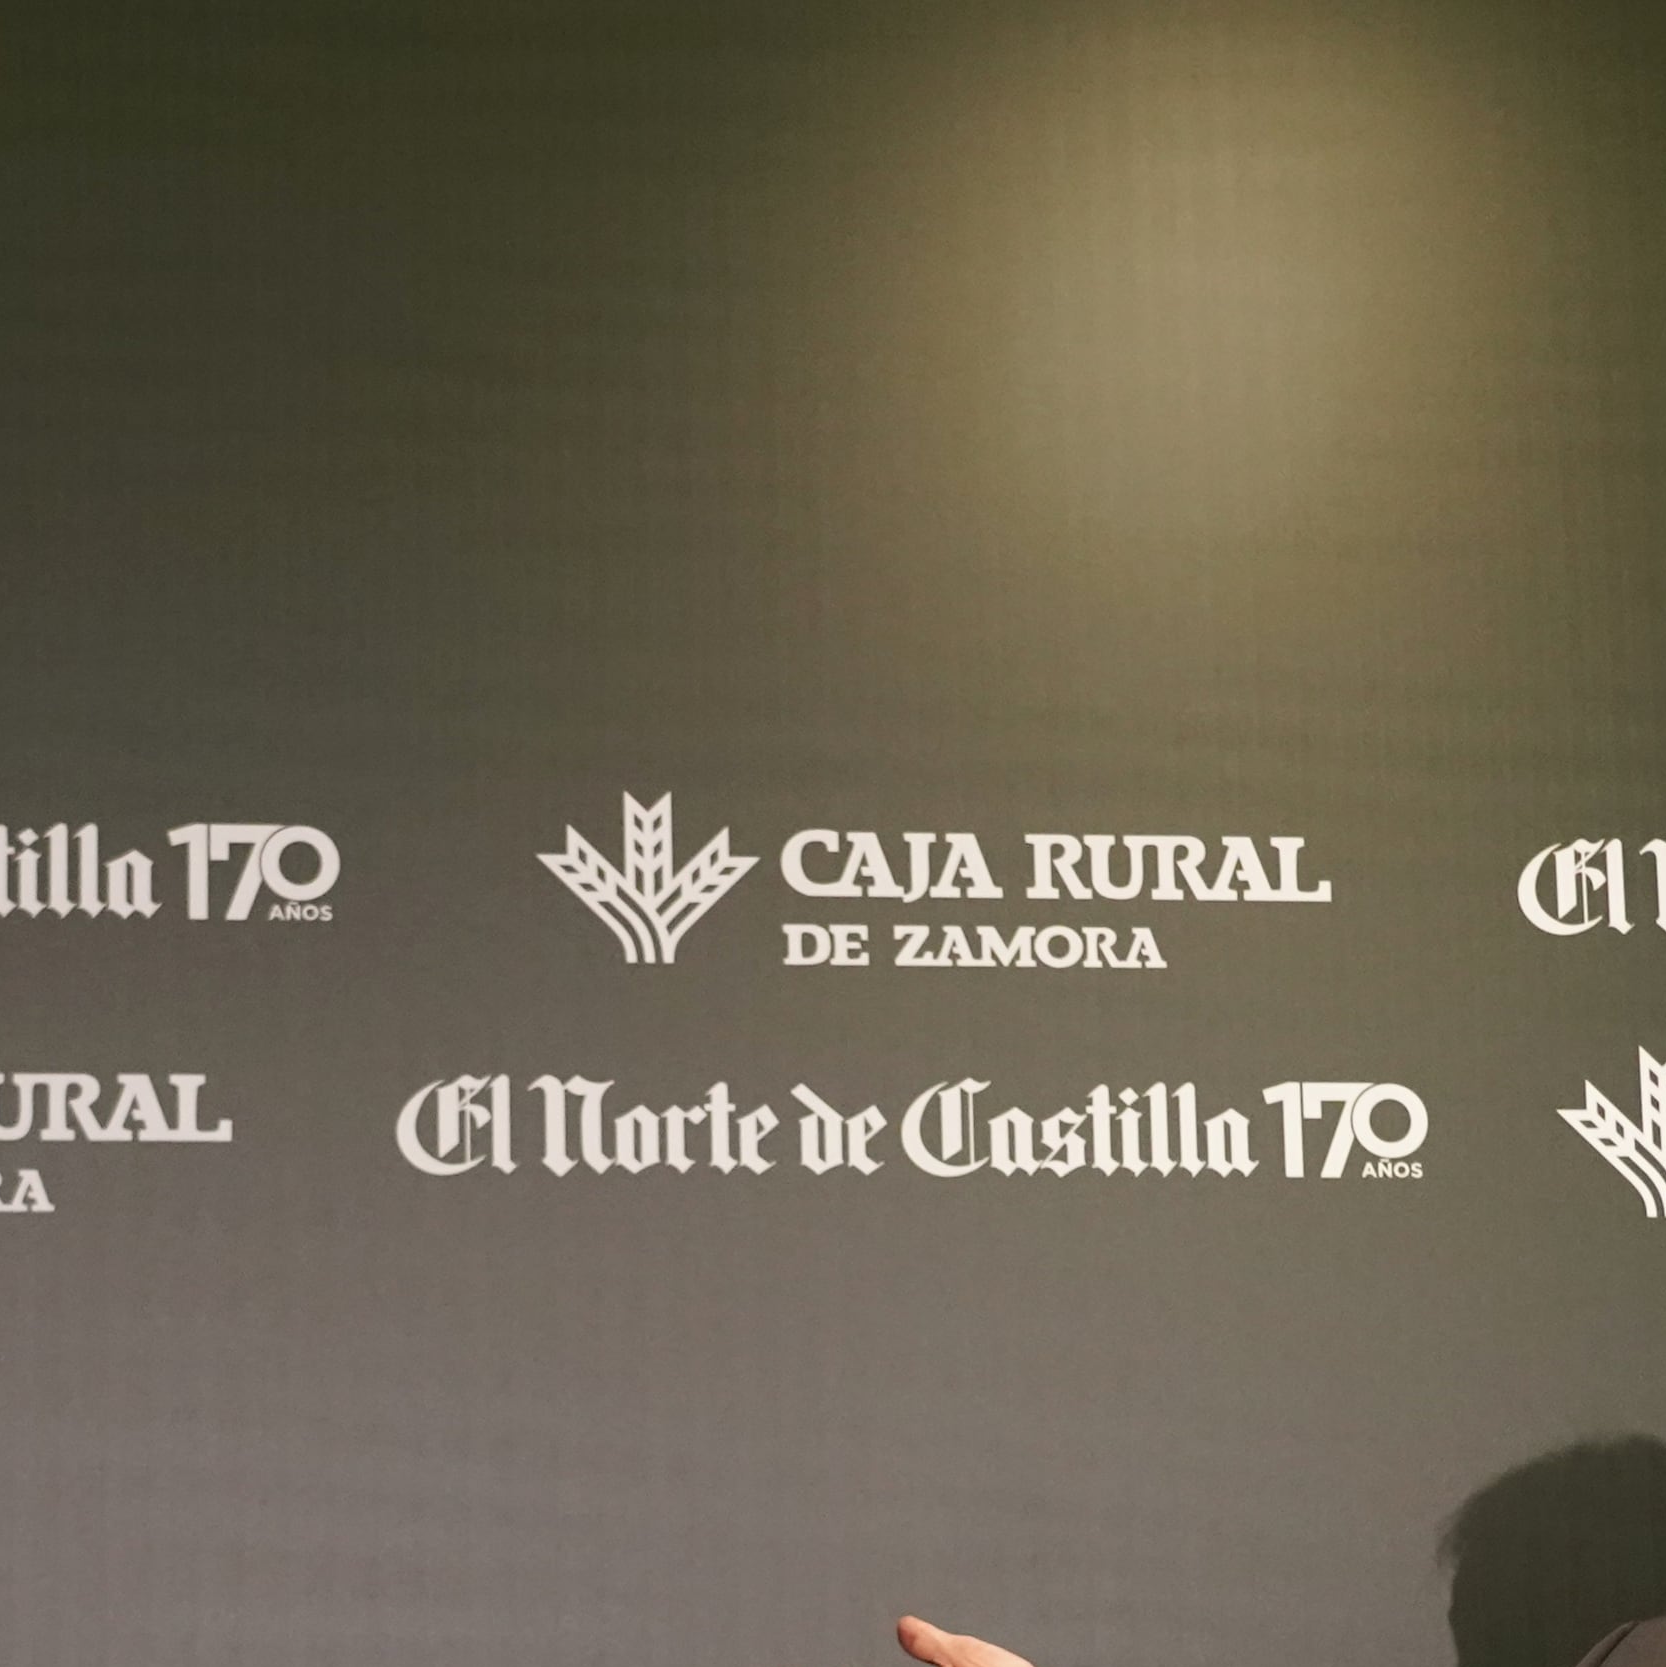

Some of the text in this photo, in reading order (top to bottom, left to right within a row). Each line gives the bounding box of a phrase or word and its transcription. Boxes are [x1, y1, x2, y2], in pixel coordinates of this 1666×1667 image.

[167, 823, 341, 922] 170
[780, 828, 1332, 903] CAJA RURAL
[1517, 838, 1634, 936] El
[268, 902, 333, 922] AÑOS
[782, 923, 1168, 969] DE ZAMORA
[396, 1073, 1429, 1179] El Norte de Castilla 170
[1361, 1157, 1424, 1179] AÑOS
